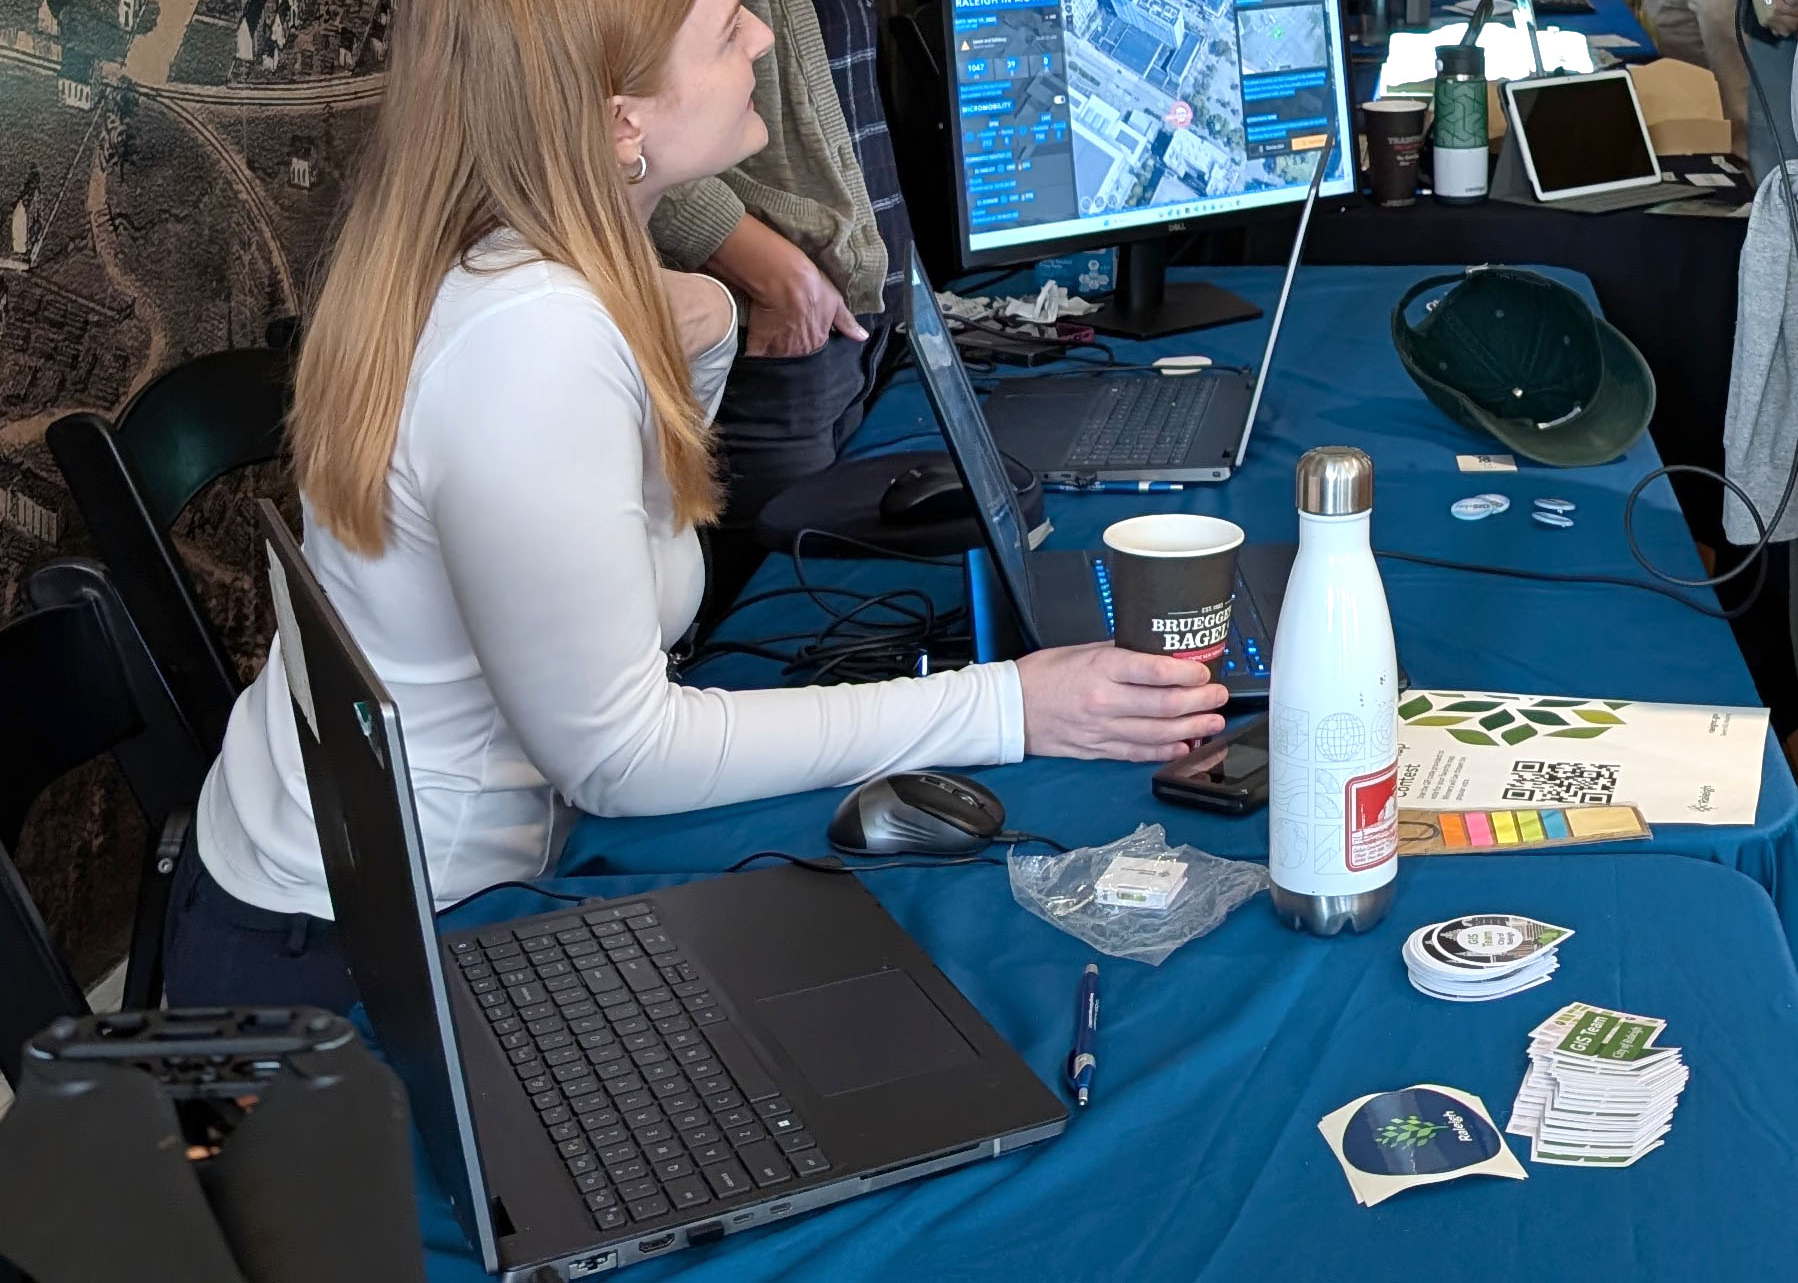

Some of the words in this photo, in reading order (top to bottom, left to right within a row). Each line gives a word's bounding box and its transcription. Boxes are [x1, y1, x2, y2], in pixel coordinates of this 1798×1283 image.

[1162, 620, 1229, 651] BAGEL
[1467, 933, 1479, 945] GIS
[1482, 931, 1493, 947] Team
[1580, 1016, 1609, 1036] Team
[1569, 1035, 1592, 1052] GIS
[1612, 1046, 1628, 1059] City
[1622, 1026, 1645, 1044] Raleigh
[1442, 1110, 1473, 1142] Raleigh
